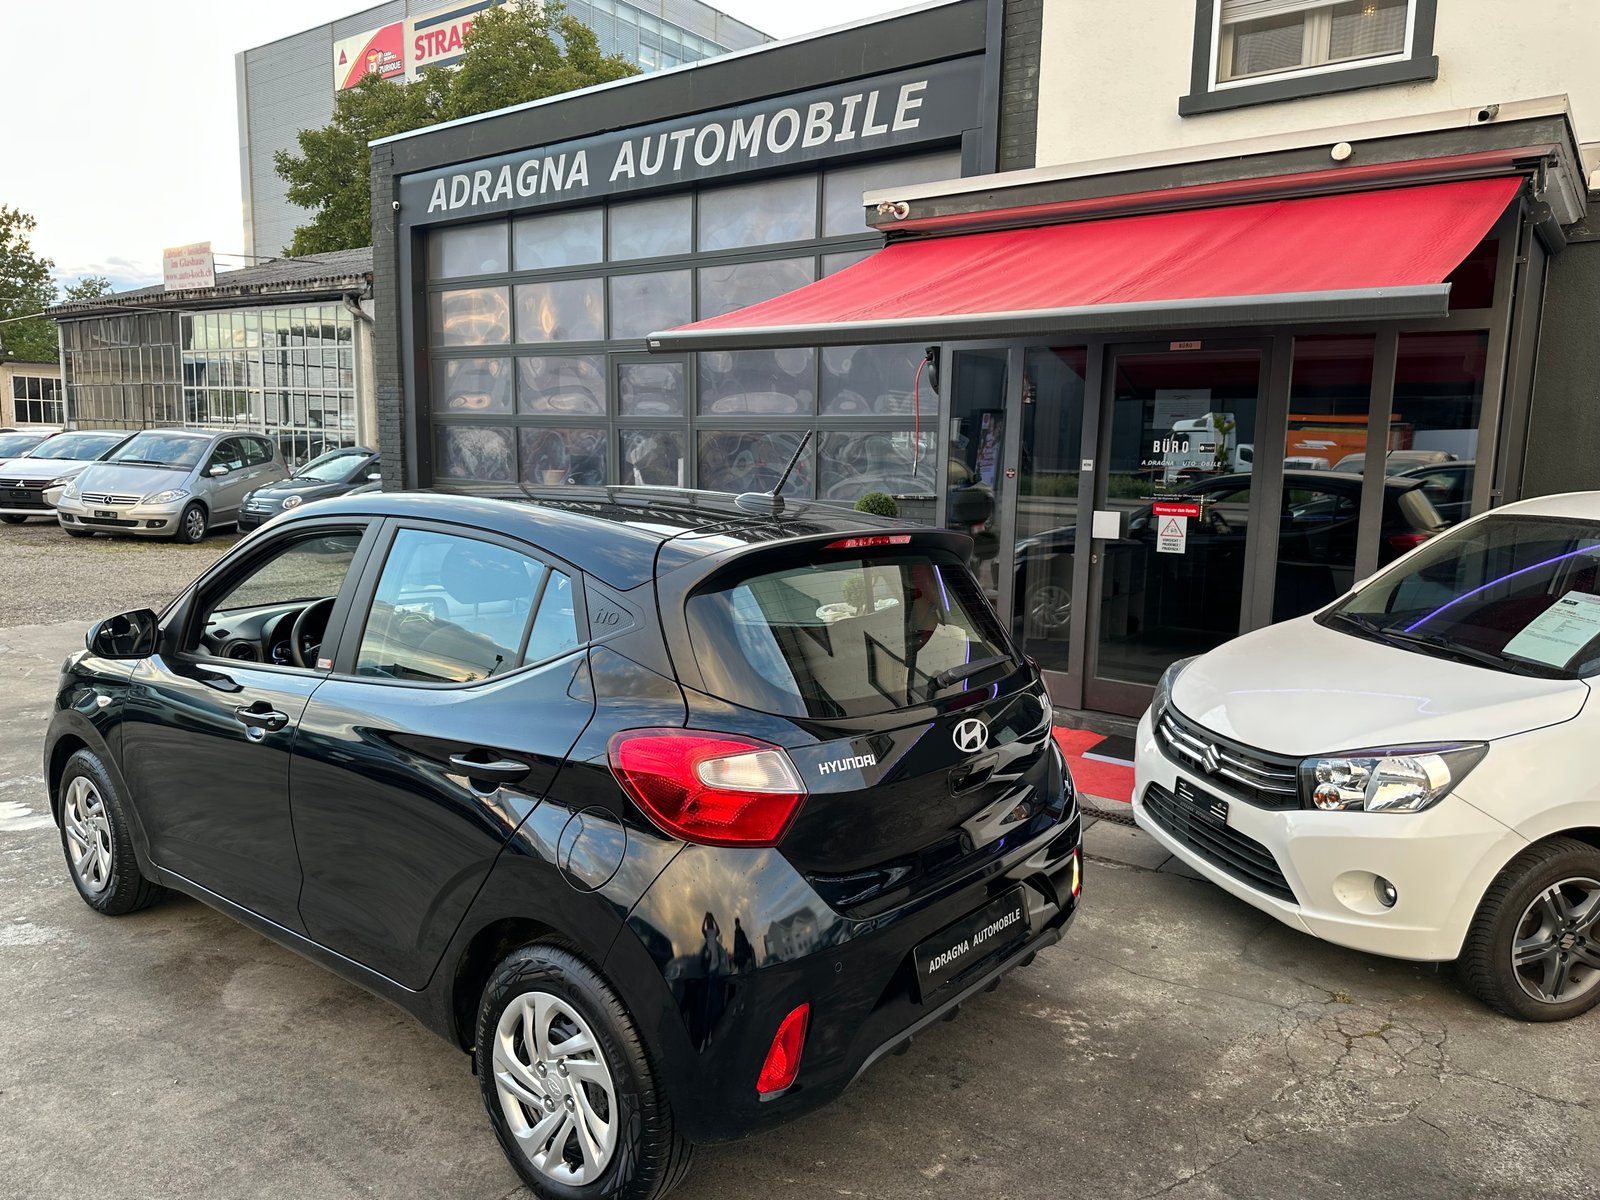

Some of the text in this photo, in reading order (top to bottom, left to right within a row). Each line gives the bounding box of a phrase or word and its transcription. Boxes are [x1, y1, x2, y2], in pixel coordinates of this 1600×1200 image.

[427, 80, 928, 213] ADRAGNA AUTOMOBILE
[1152, 438, 1189, 453] BÜRO
[594, 608, 620, 626] i10
[818, 754, 876, 775] HYUNDAI
[928, 908, 1020, 974] ADRAGNA AUTOMOBILE
